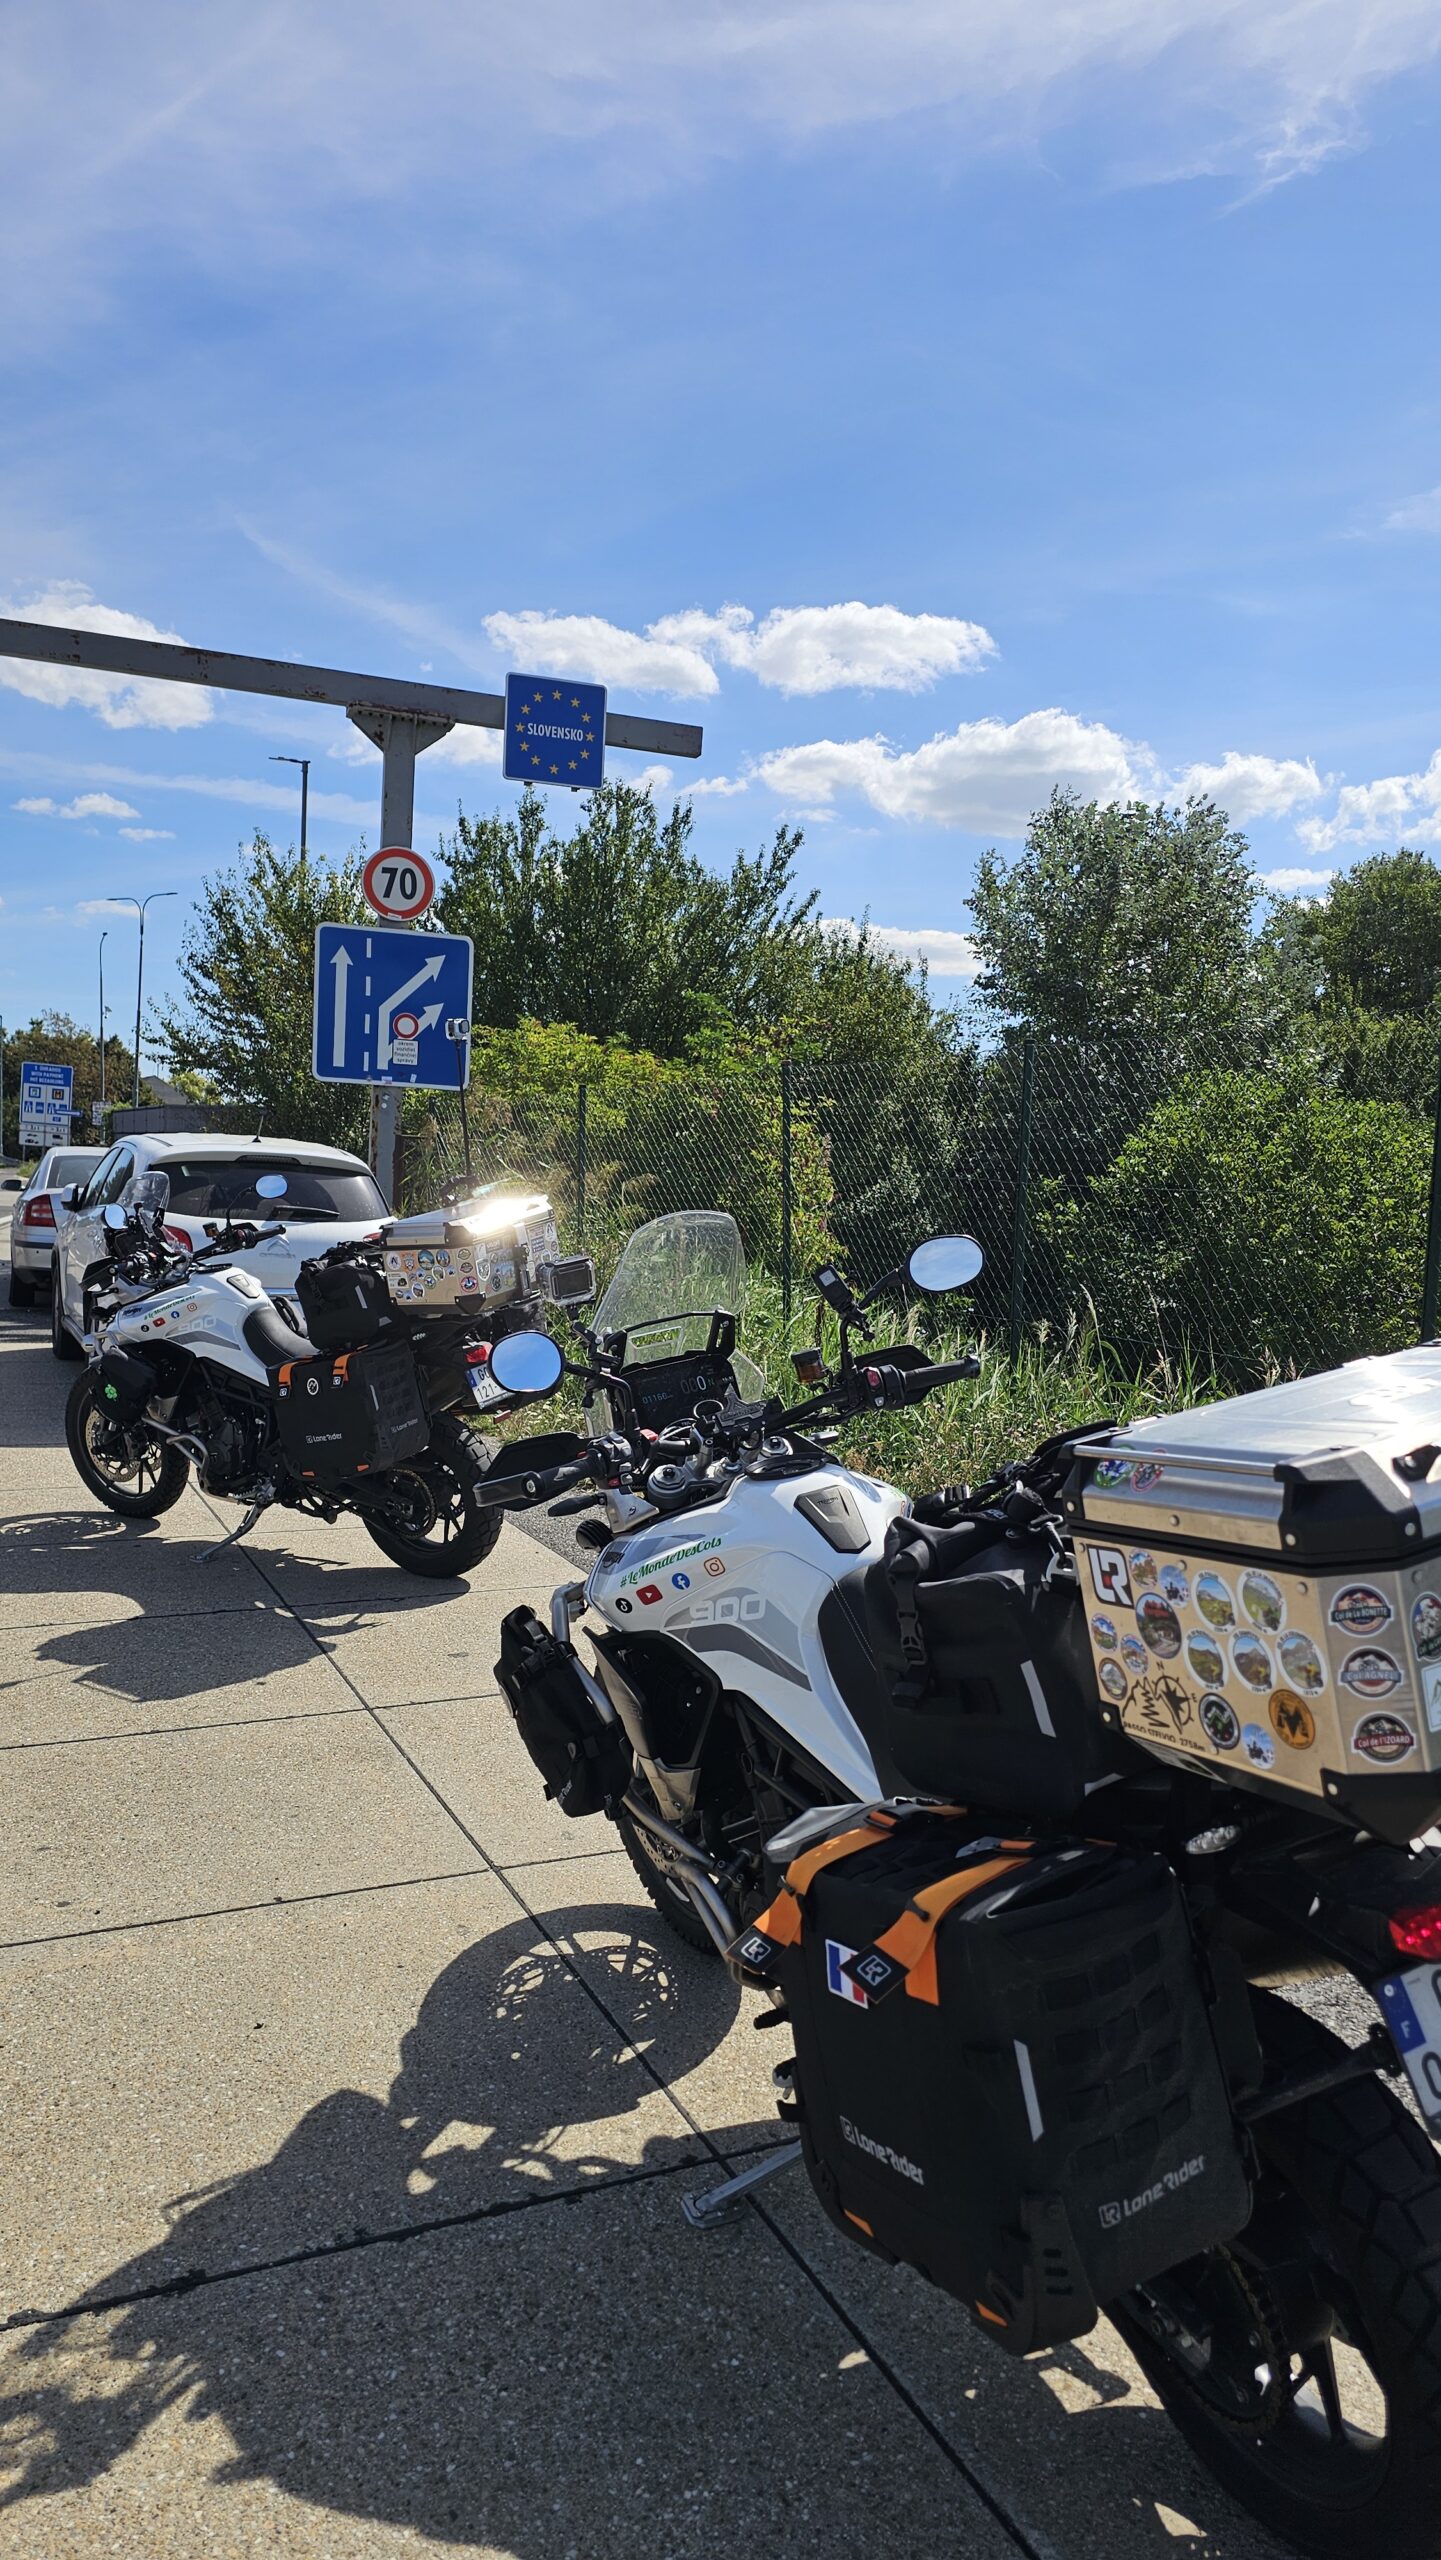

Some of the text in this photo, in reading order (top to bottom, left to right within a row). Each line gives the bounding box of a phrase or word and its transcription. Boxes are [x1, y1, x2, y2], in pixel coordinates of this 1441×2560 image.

[527, 722, 584, 742] SLOVENSKO
[381, 867, 417, 900] 70
[620, 1537, 722, 1588] #LeMondeDesCols
[690, 1593, 768, 1625] 900
